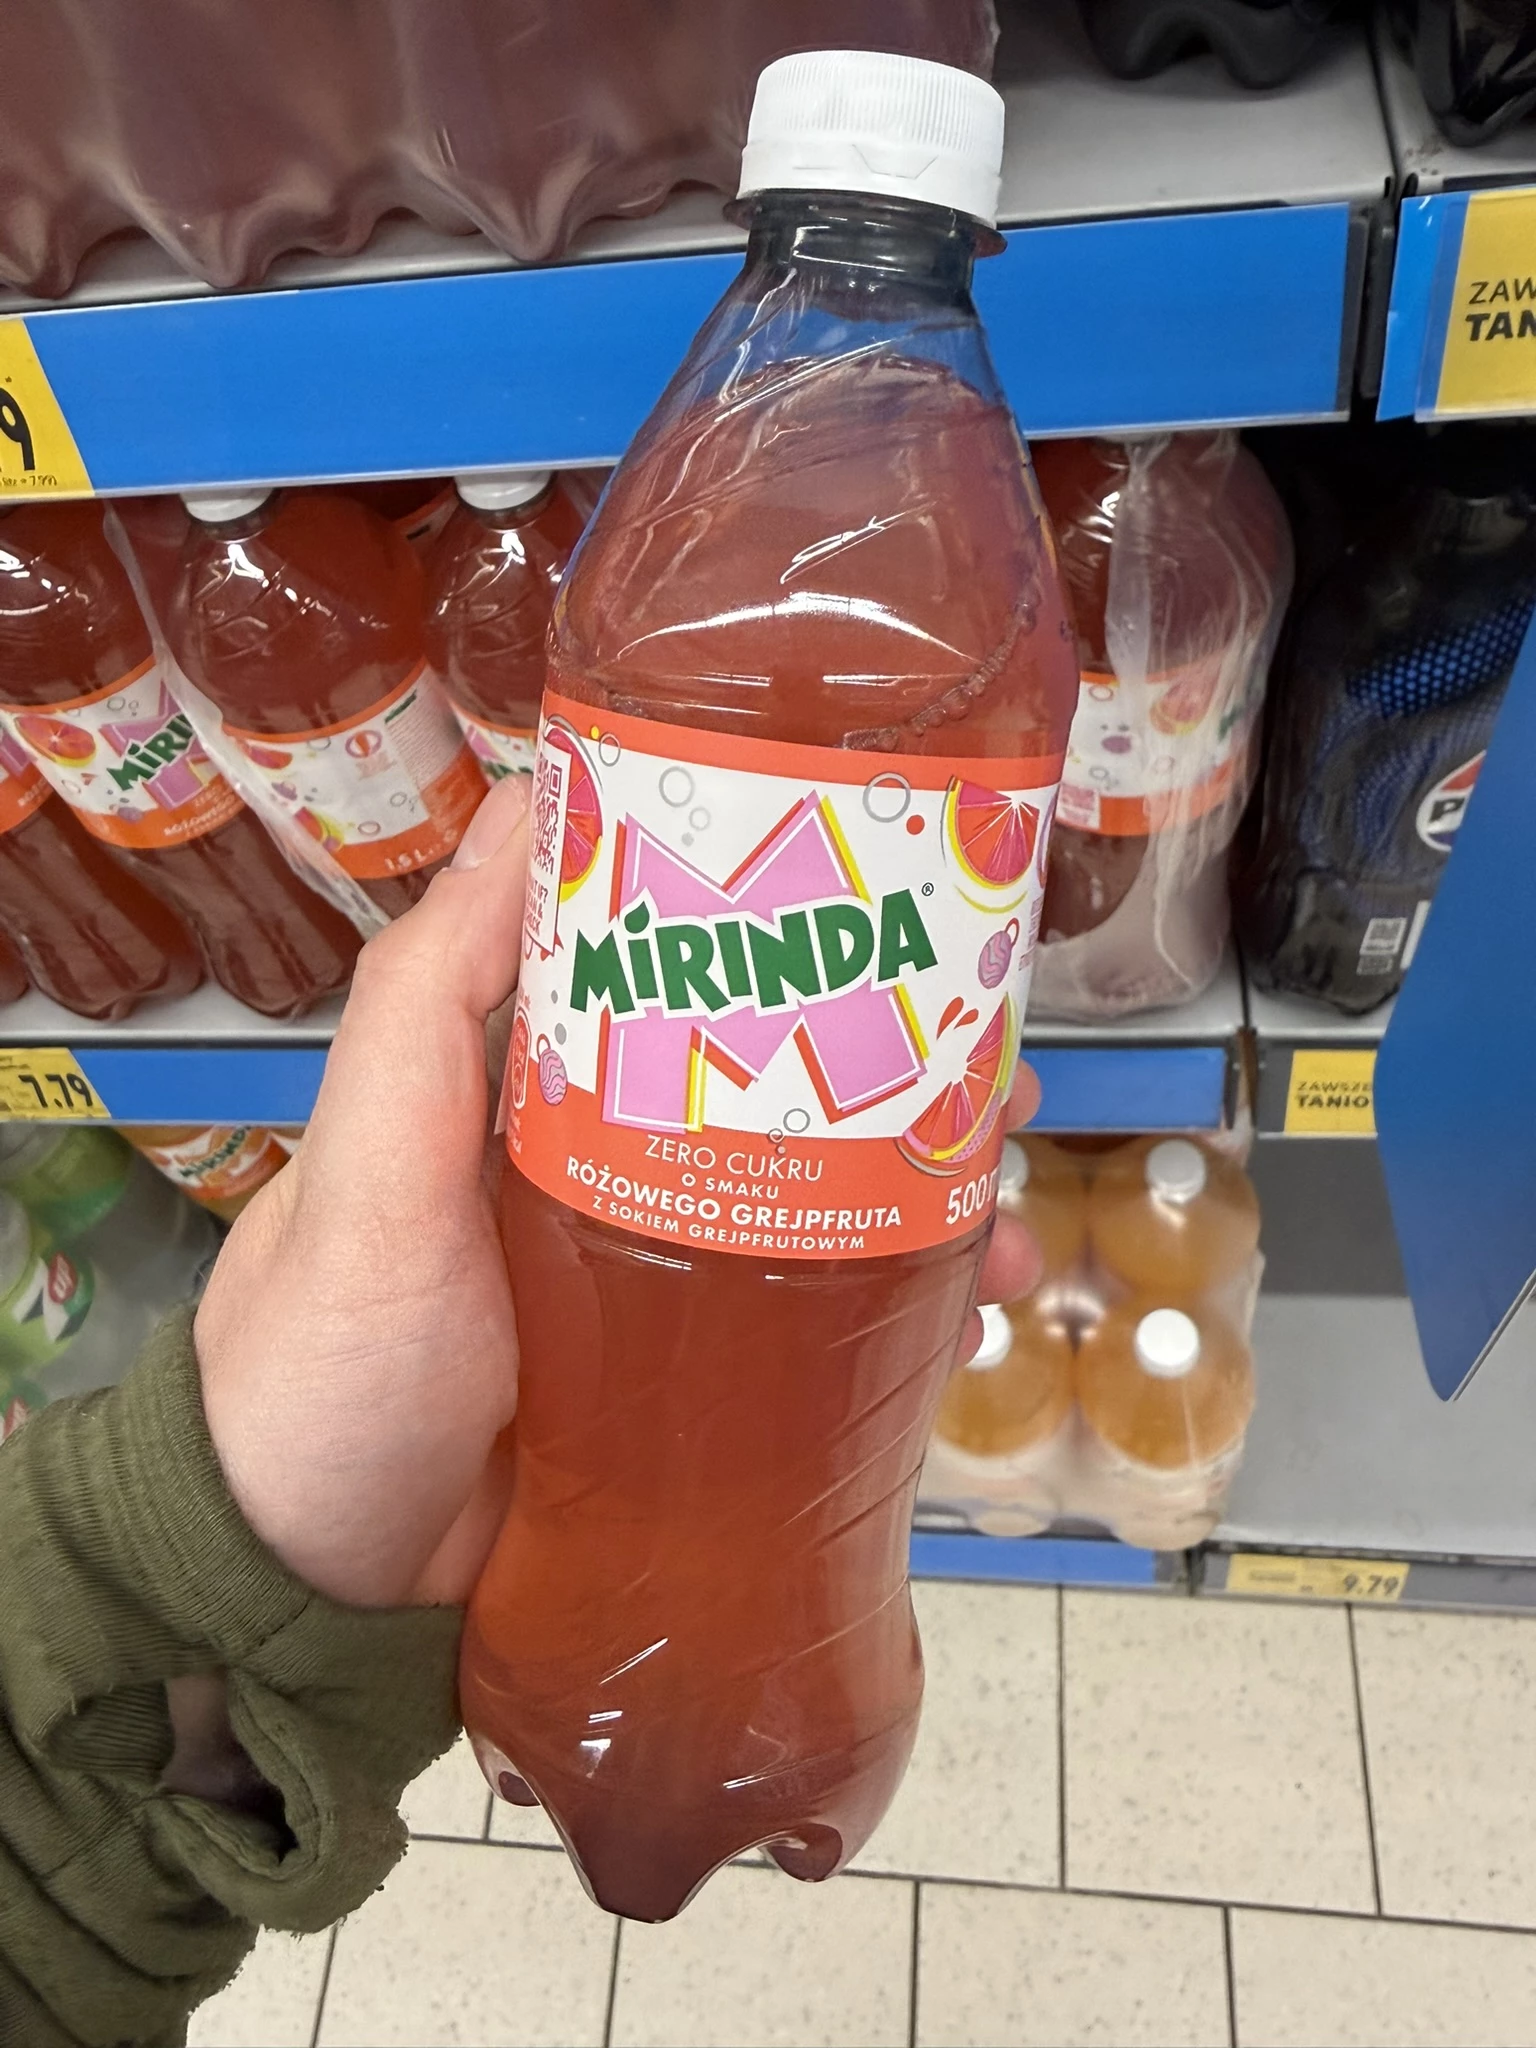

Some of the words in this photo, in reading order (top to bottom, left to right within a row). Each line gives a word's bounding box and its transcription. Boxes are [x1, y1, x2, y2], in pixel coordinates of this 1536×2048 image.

[18, 1072, 94, 1109] 7.79
[1298, 1094, 1370, 1109] TANIO
[645, 1133, 717, 1169] ZERO
[726, 1152, 824, 1183] CUKRU
[566, 1155, 721, 1221] RÓŻOWEGO
[730, 1205, 902, 1232] GREJPFRUTA
[681, 1173, 697, 1188] O
[705, 1177, 780, 1200] SMAKU
[592, 1195, 603, 1210] Z
[608, 1202, 680, 1234] SOKIEM
[688, 1223, 866, 1250] GREJPFRUTOWYM
[1343, 1573, 1400, 1599] 9.79
